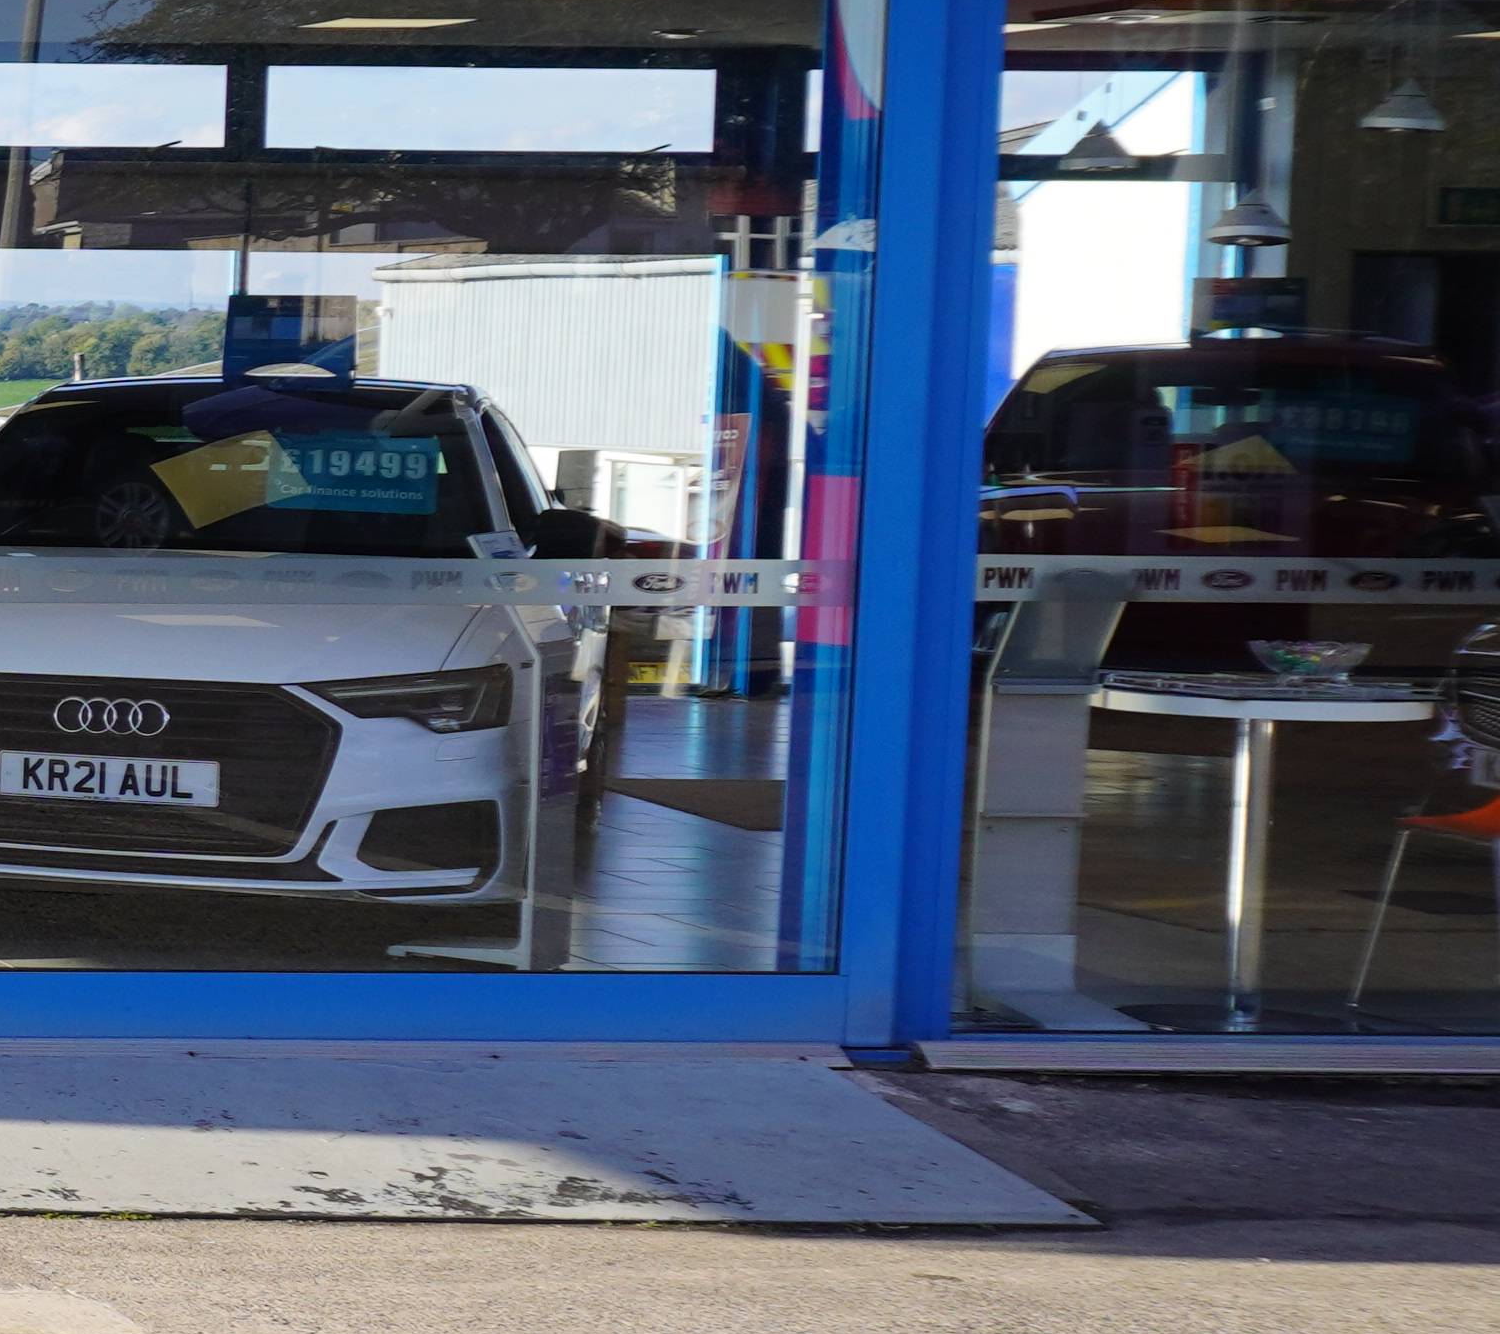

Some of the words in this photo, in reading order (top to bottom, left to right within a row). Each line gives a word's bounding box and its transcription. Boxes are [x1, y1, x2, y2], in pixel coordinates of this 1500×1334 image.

[280, 448, 428, 480] £19499
[280, 484, 302, 495] Car
[308, 485, 357, 498] finance
[360, 488, 425, 500] solutions
[983, 567, 1034, 589] PWM
[1275, 569, 1328, 592] PWM
[23, 757, 106, 794] KR21
[119, 760, 194, 799] AUL
